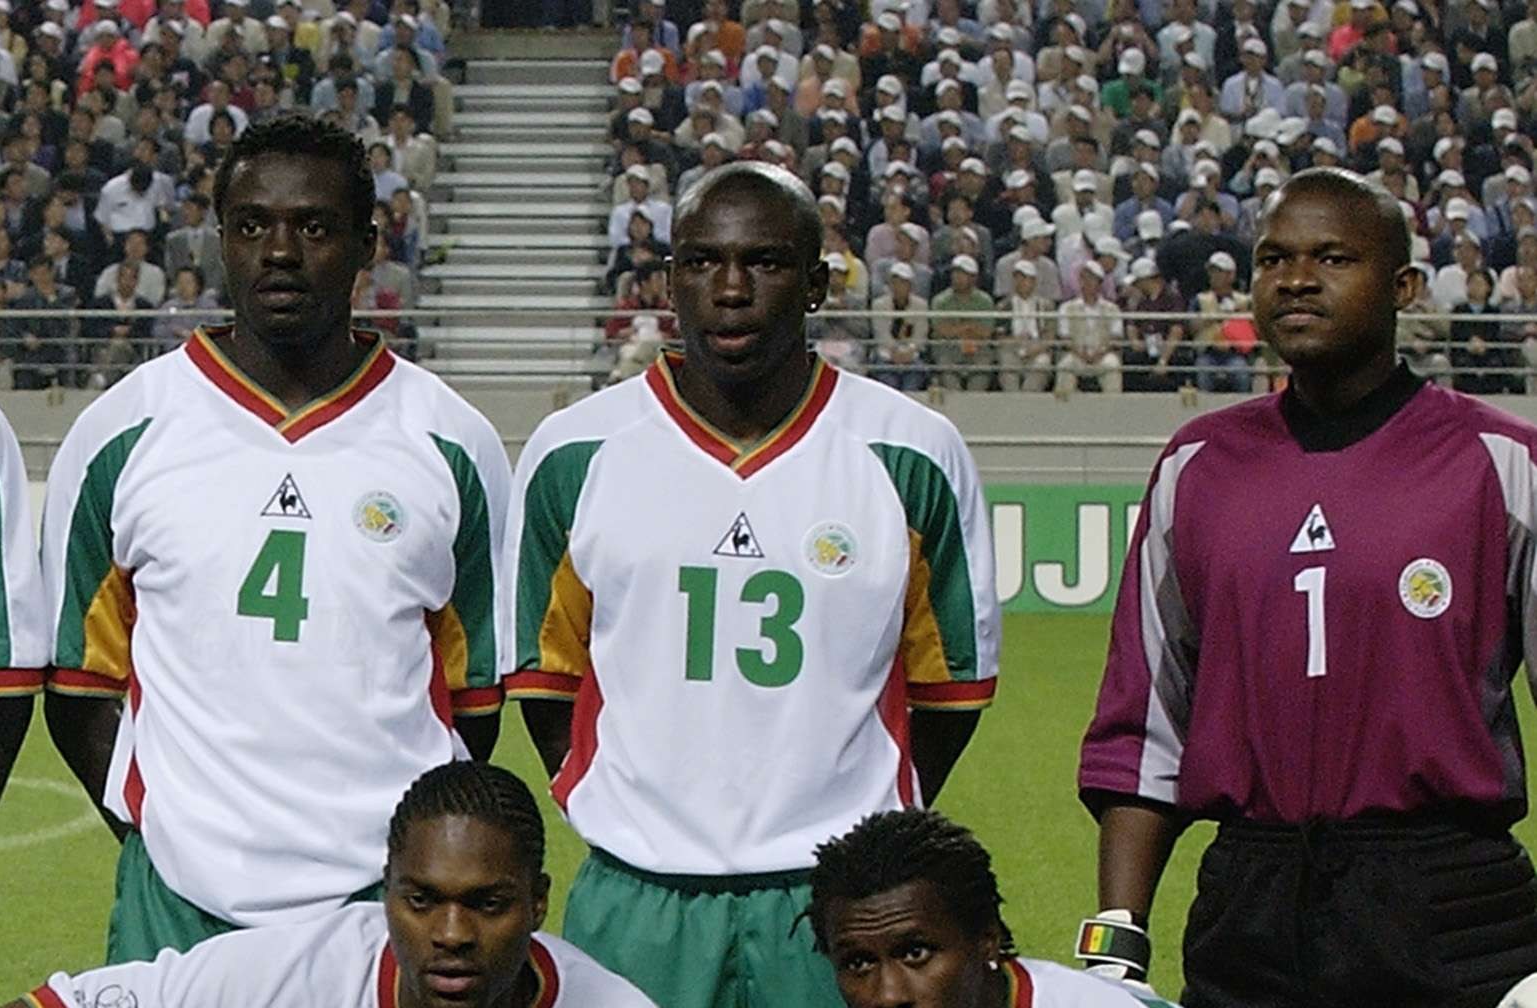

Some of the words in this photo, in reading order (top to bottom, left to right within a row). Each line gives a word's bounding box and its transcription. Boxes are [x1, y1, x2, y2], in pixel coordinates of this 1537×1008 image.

[237, 529, 309, 642] 4
[678, 565, 805, 687] 13
[1294, 566, 1327, 677] 1
